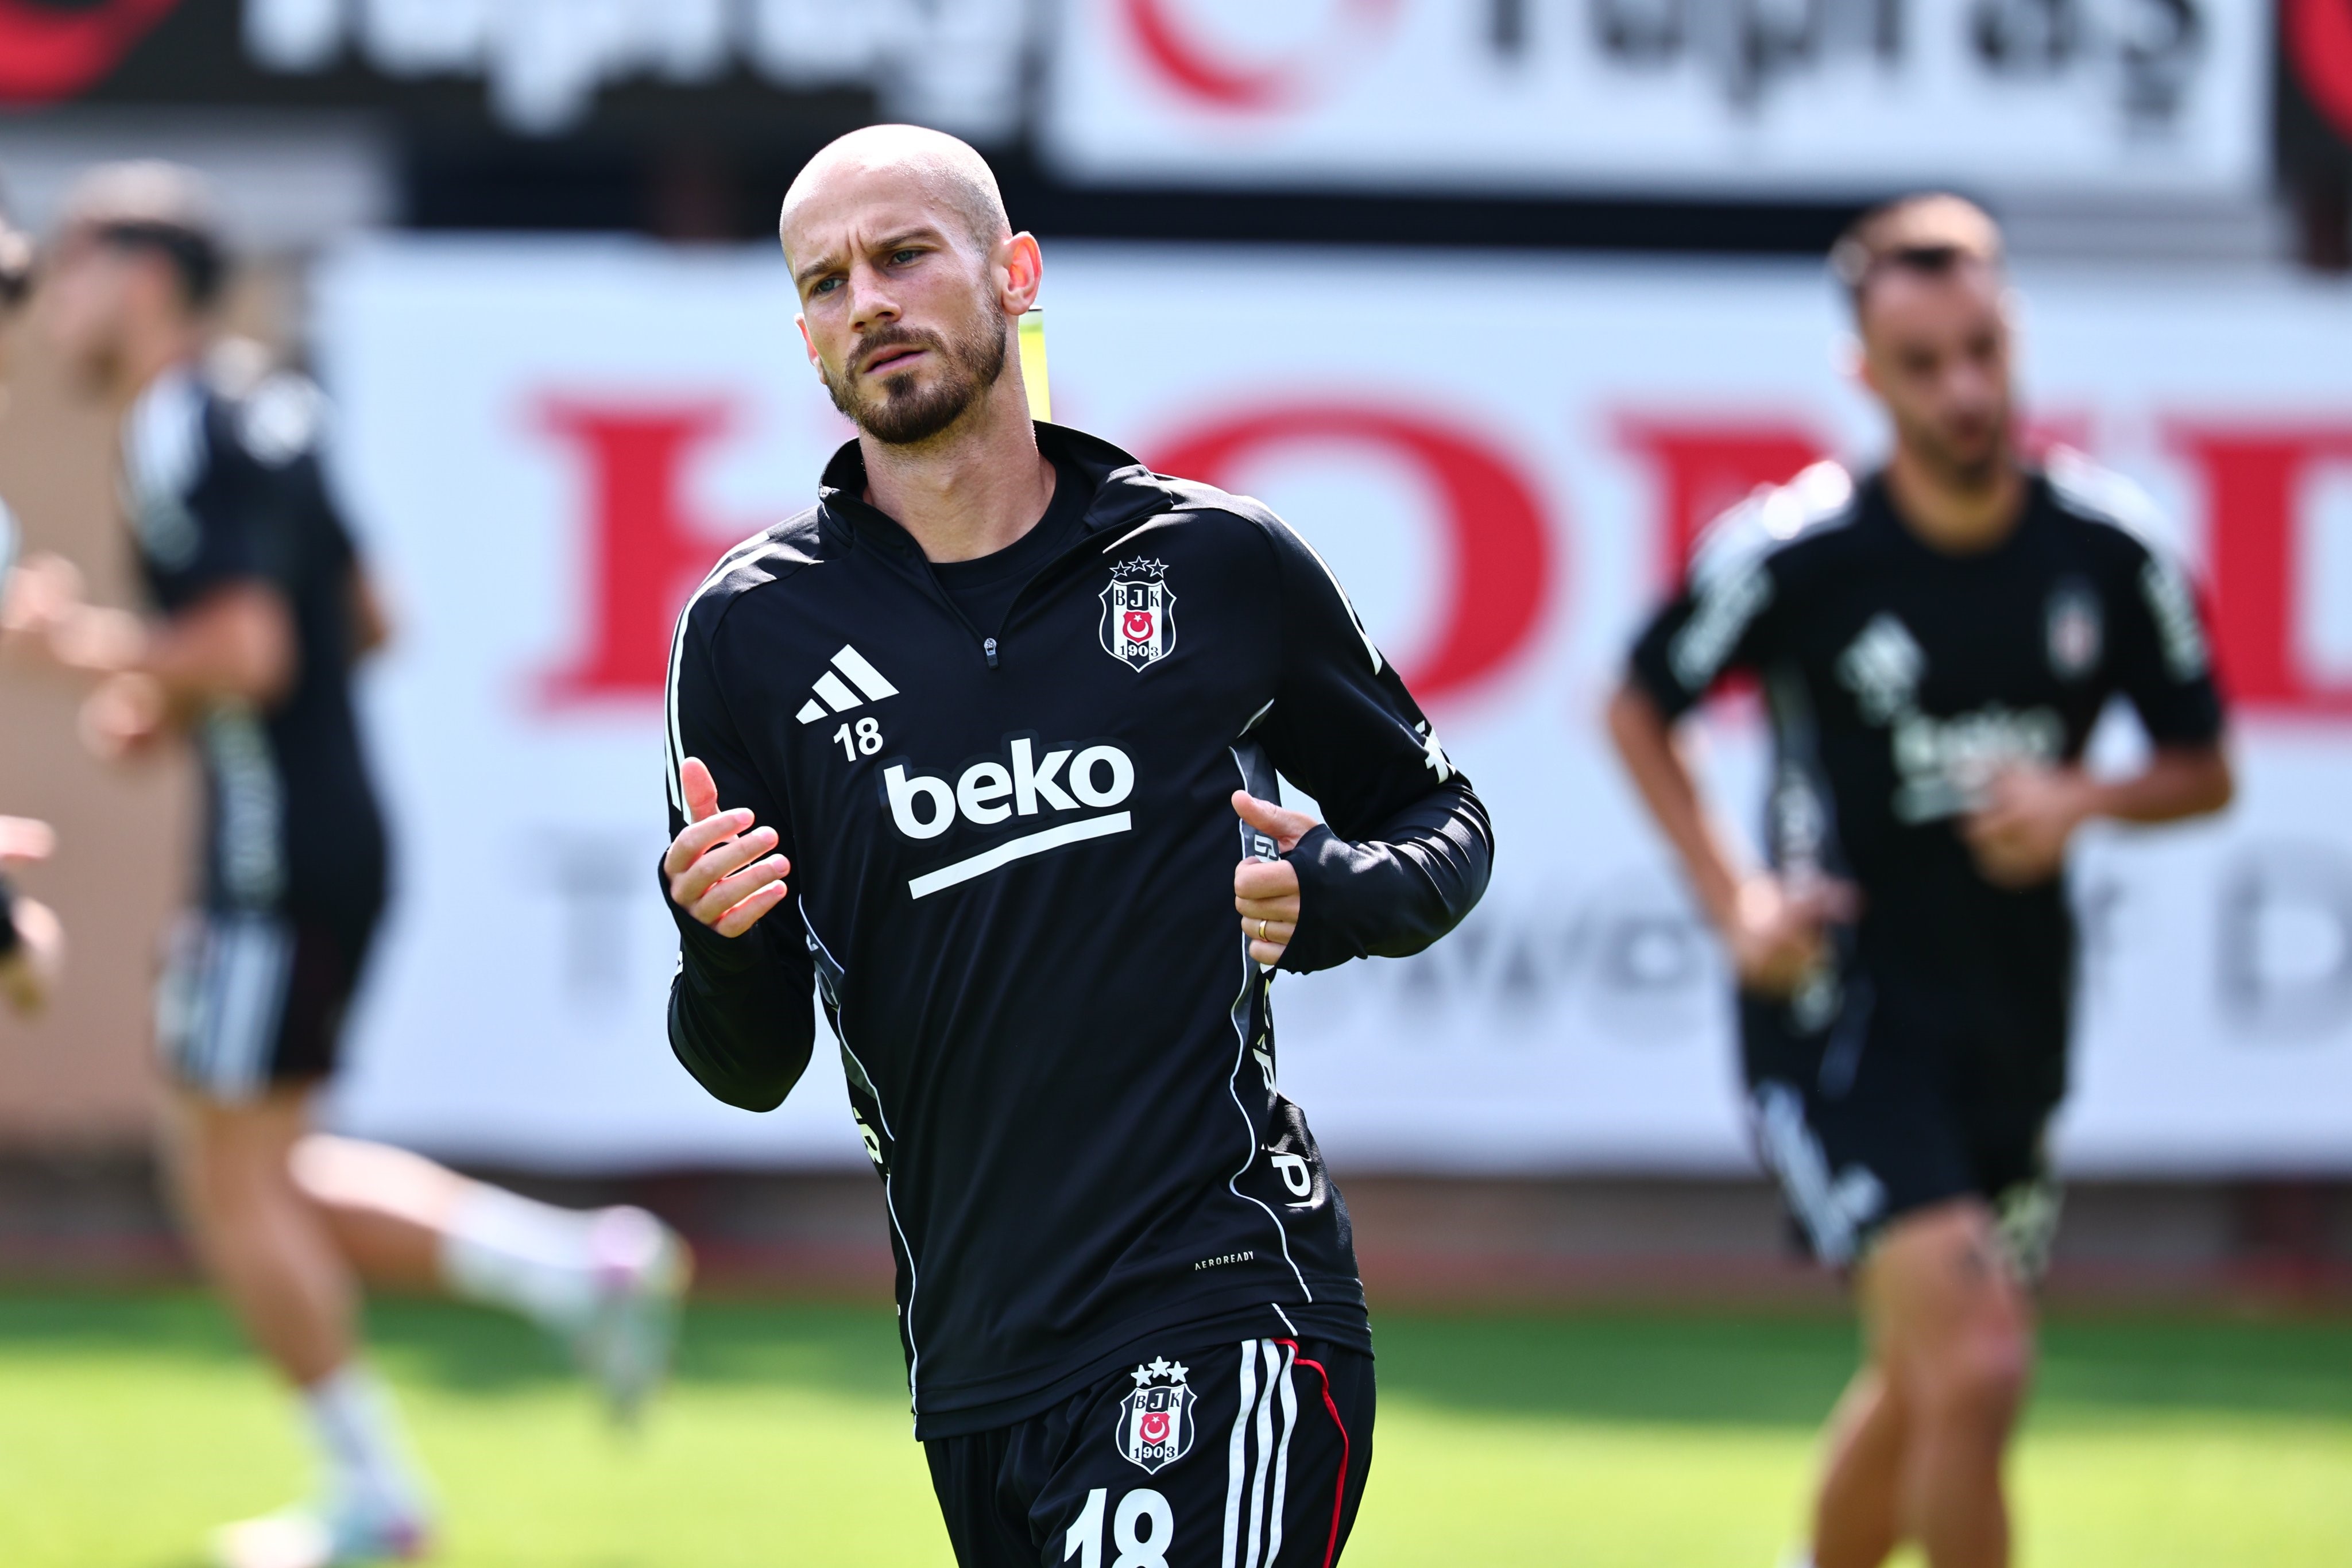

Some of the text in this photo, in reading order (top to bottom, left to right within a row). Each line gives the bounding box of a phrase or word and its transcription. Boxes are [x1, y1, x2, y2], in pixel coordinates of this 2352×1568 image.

[1115, 589, 1160, 607] BJK
[1120, 645, 1159, 657] 1903
[833, 717, 884, 762] 18
[884, 738, 1135, 839] beko
[1195, 1250, 1254, 1271] AEROREADY
[1134, 1392, 1181, 1410] BJK
[1134, 1446, 1177, 1459] 1903
[1064, 1488, 1174, 1568] 18
